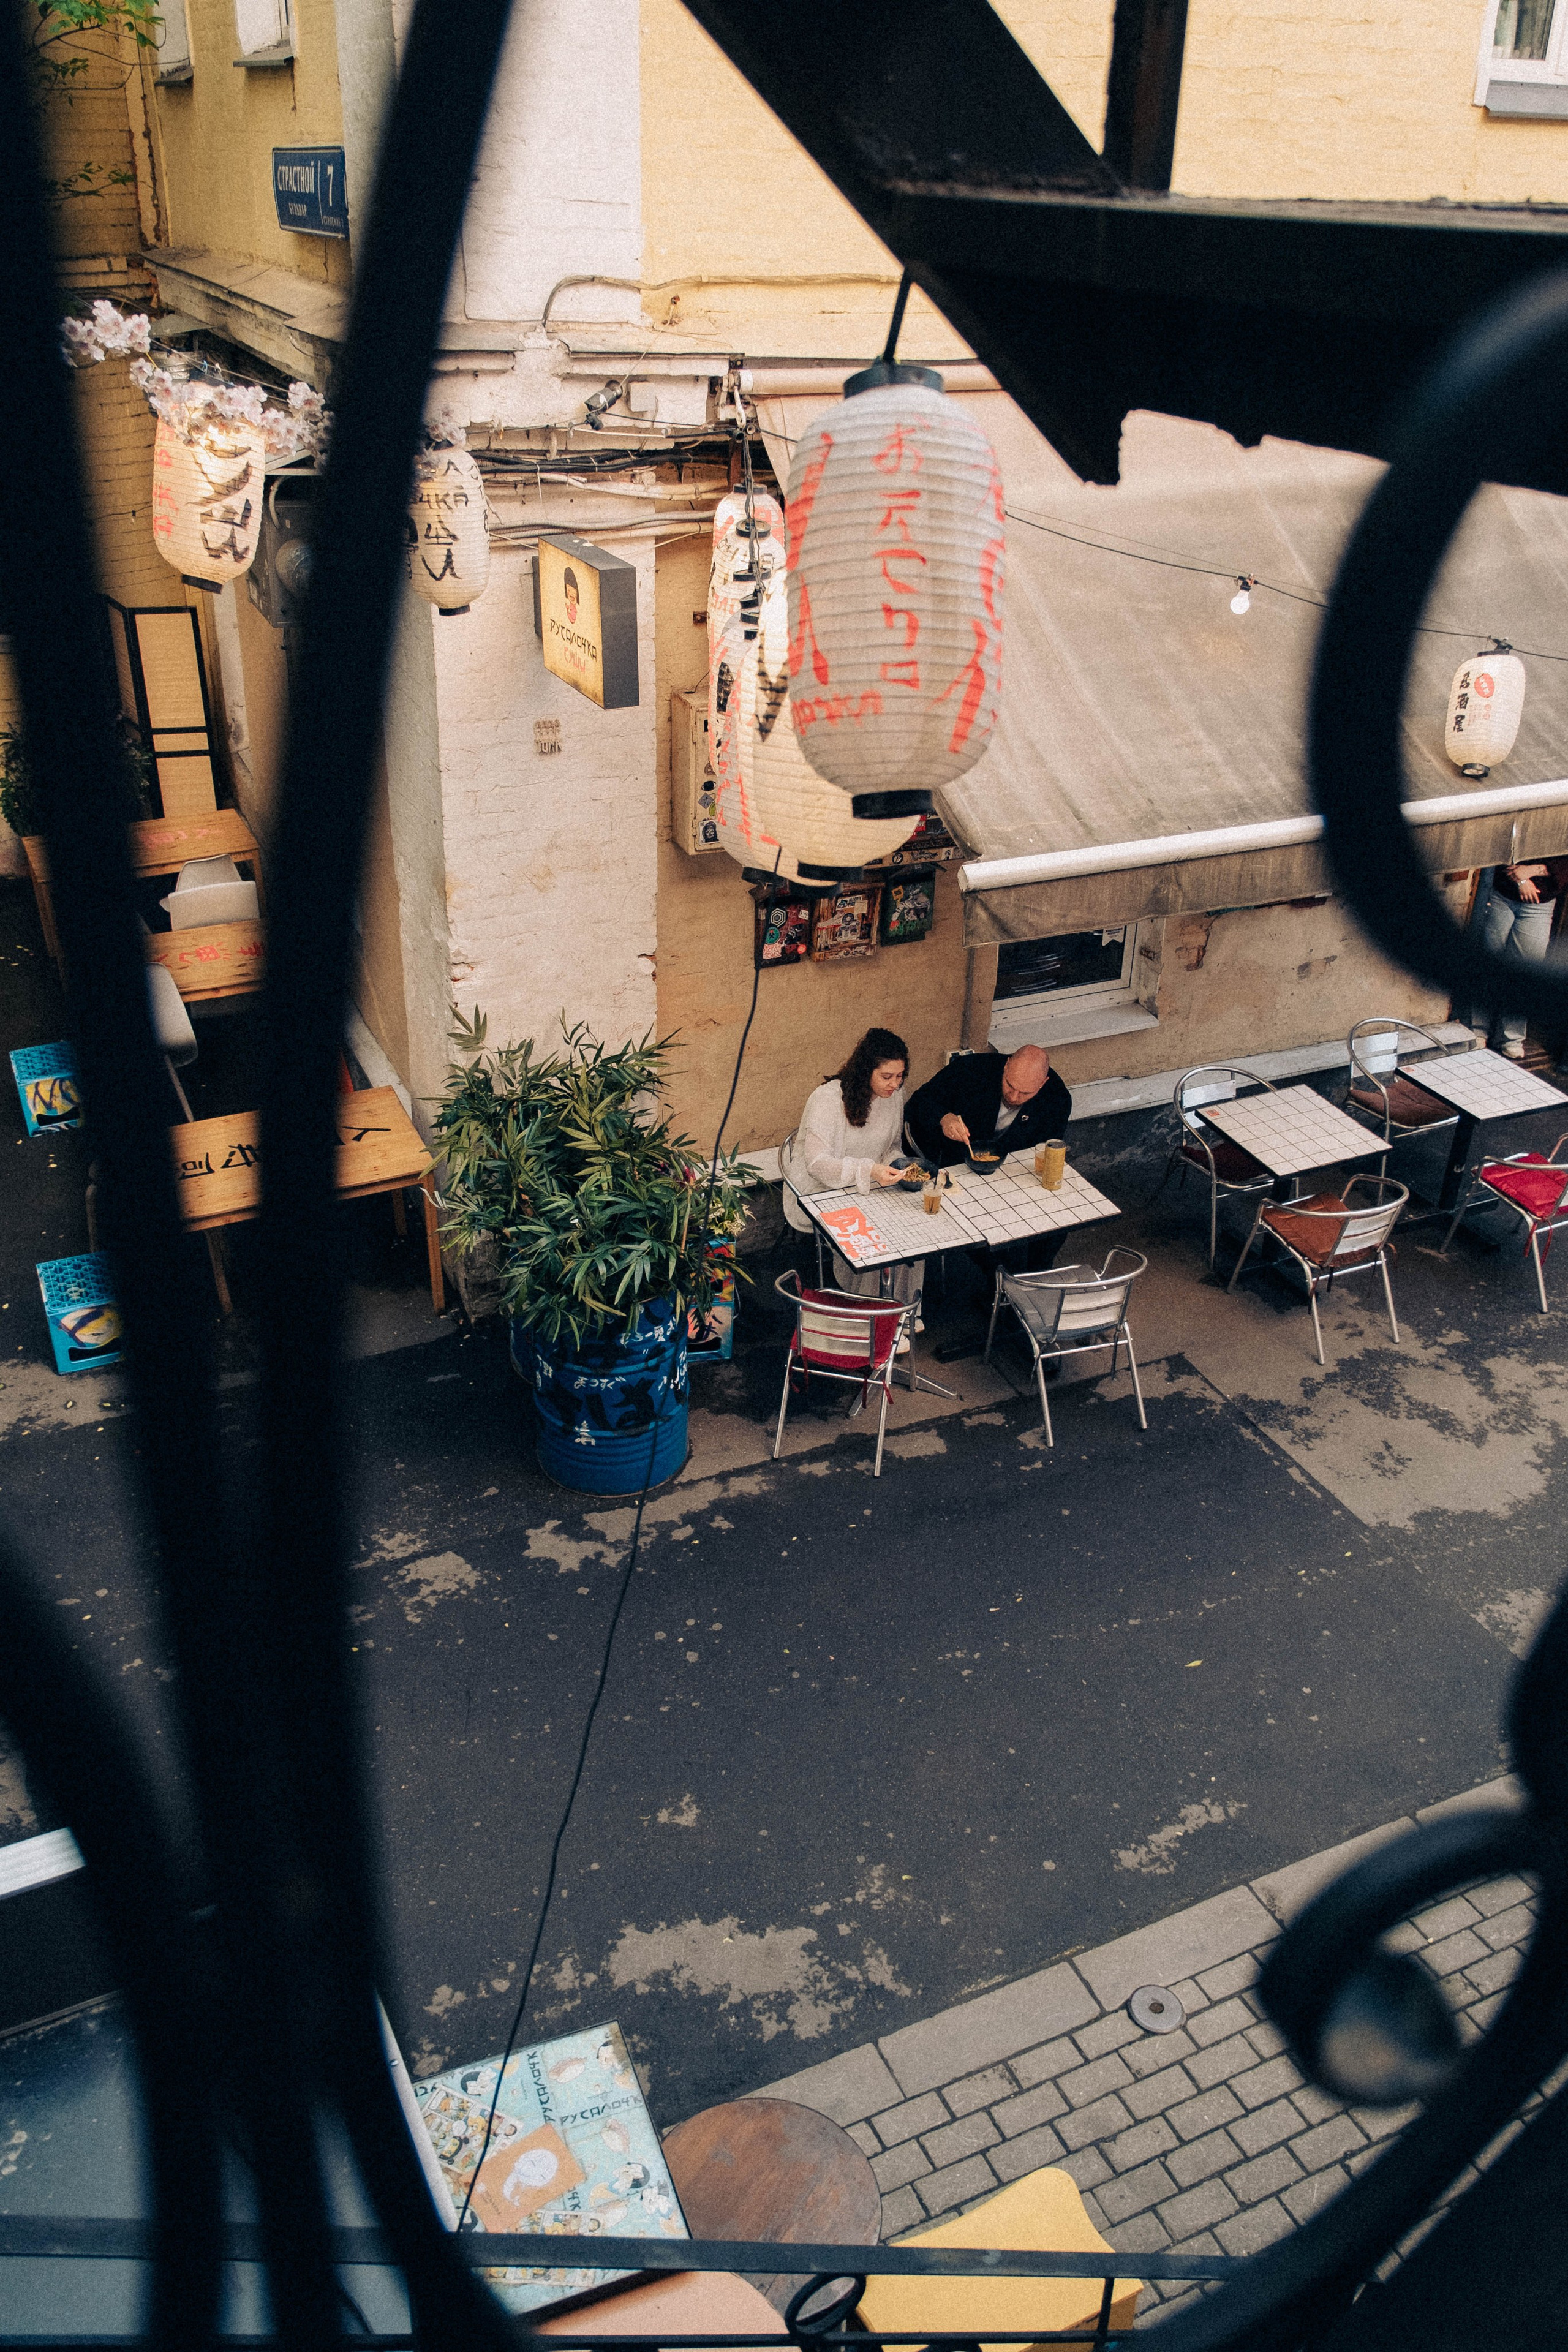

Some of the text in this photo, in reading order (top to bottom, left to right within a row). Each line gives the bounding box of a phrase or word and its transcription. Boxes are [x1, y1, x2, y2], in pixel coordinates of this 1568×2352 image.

[277, 160, 334, 207] СТРАСТНОЙ 7
[549, 618, 597, 662] РУСАЛОЧКА
